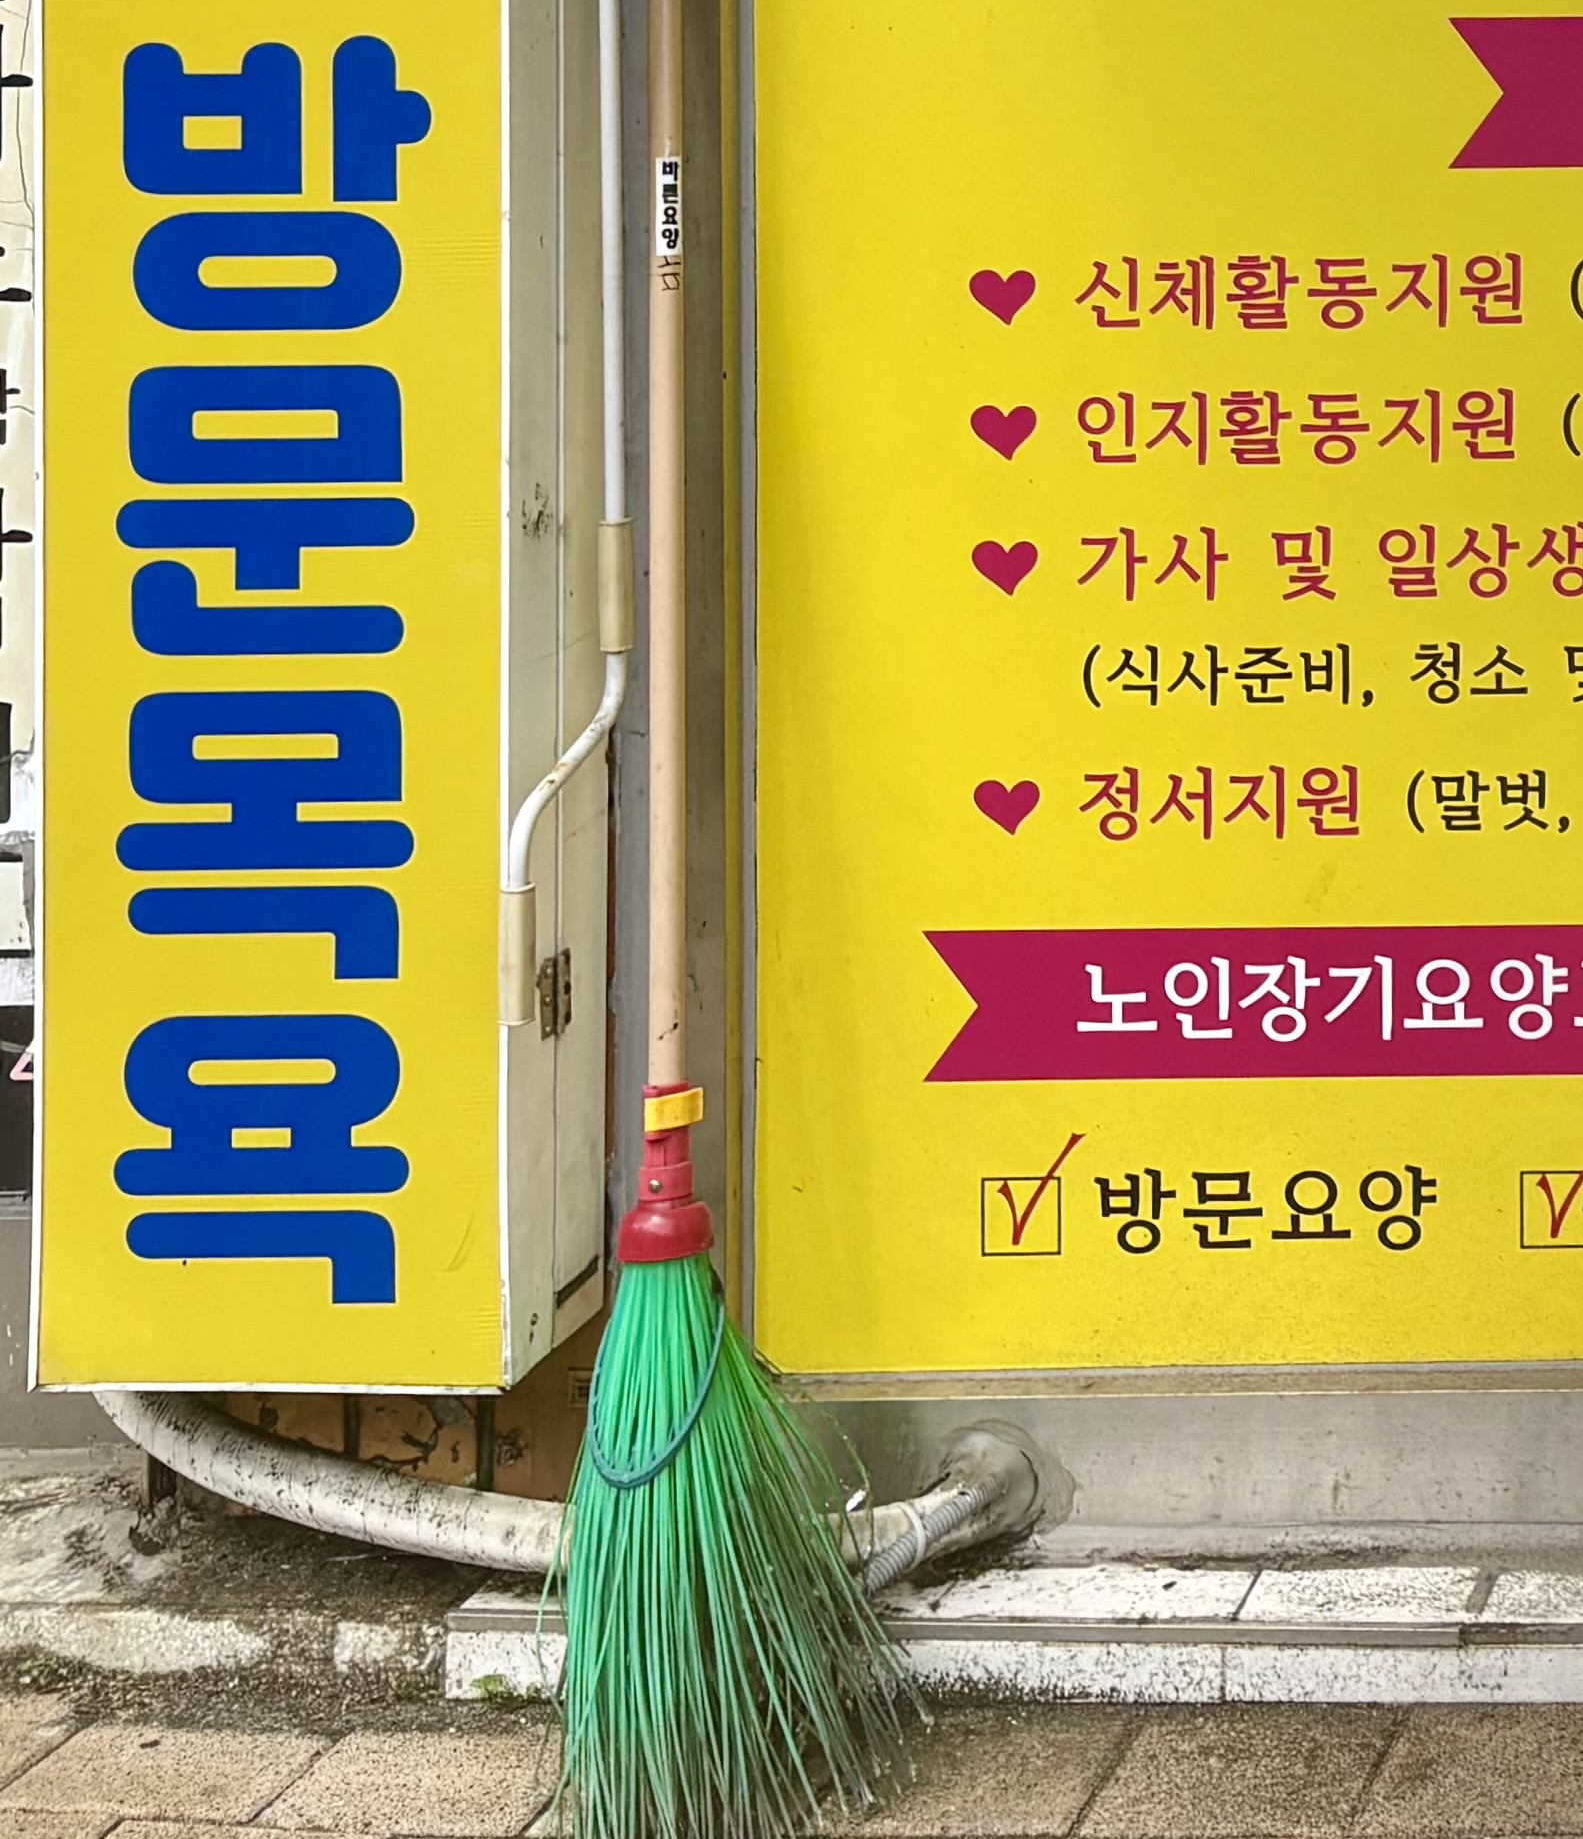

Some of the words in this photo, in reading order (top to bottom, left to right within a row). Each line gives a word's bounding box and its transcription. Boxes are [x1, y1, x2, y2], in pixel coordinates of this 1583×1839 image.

[661, 160, 680, 250] 바른요양
[1074, 251, 1526, 332] 신체활동지원
[1076, 387, 1518, 466] 인지활동지원
[1076, 525, 1229, 603] 가사
[1272, 524, 1338, 603] 및
[114, 34, 432, 1305] 방문목욕
[1081, 640, 1376, 709] (식사준비,
[1408, 640, 1529, 703] 청소
[1077, 764, 1361, 843] 정서지원
[1405, 768, 1572, 834] (말벗,
[1094, 1164, 1438, 1256] 방문요양
